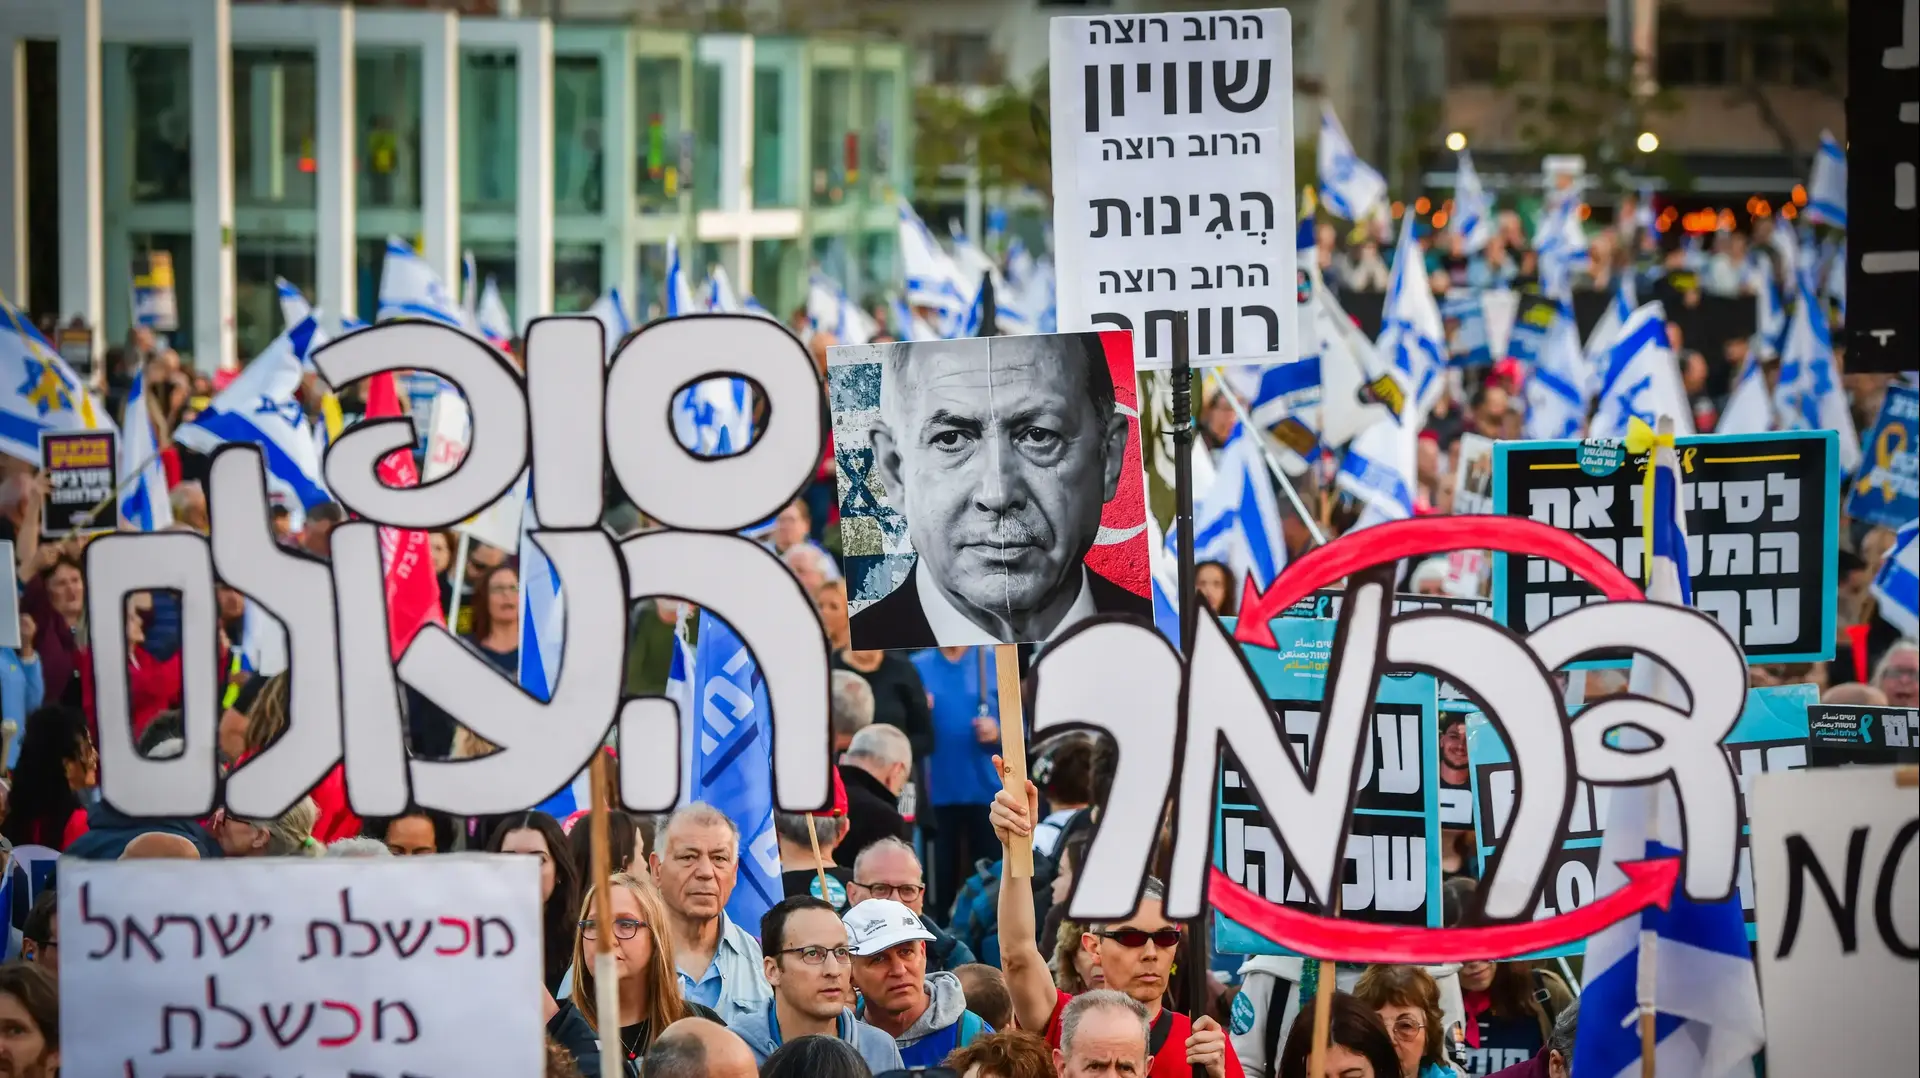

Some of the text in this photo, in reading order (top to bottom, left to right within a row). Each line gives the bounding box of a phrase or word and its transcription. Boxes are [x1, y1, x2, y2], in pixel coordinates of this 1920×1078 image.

[1089, 15, 1263, 44] הרוב רוצה
[1084, 59, 1271, 132] שוויון
[1102, 132, 1260, 161] הרוב רוצה
[1099, 263, 1268, 294] הרוב רוצה
[1528, 473, 1800, 529] לסיי את
[86, 443, 832, 818] העולם
[79, 881, 515, 962] מכשלת ישראל
[151, 975, 421, 1054] מכשלת
